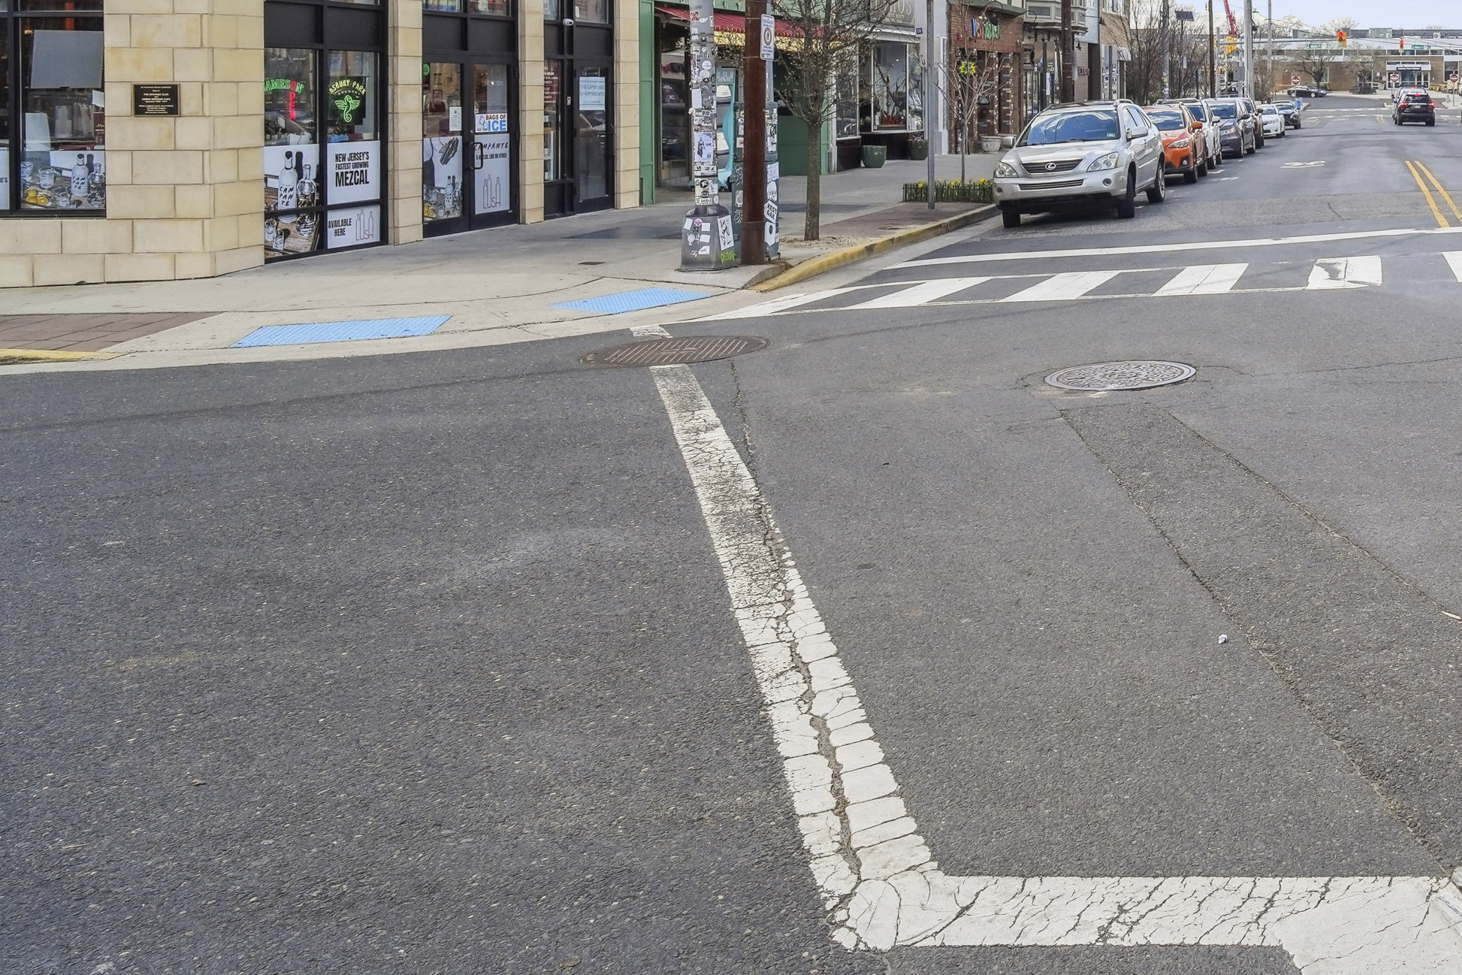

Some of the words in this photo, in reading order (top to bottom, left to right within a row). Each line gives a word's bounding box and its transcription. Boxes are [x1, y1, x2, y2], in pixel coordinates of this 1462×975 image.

[328, 78, 351, 95] ASBURY
[352, 81, 366, 95] PARK
[488, 120, 507, 132] ICE
[335, 153, 346, 163] NEW
[347, 151, 370, 162] JERSEY'S
[335, 162, 351, 171] FASTEST
[352, 161, 369, 170] GROWING
[335, 169, 370, 188] MEZCAL
[328, 217, 352, 229] AVAILABLE
[333, 228, 346, 237] HERE
